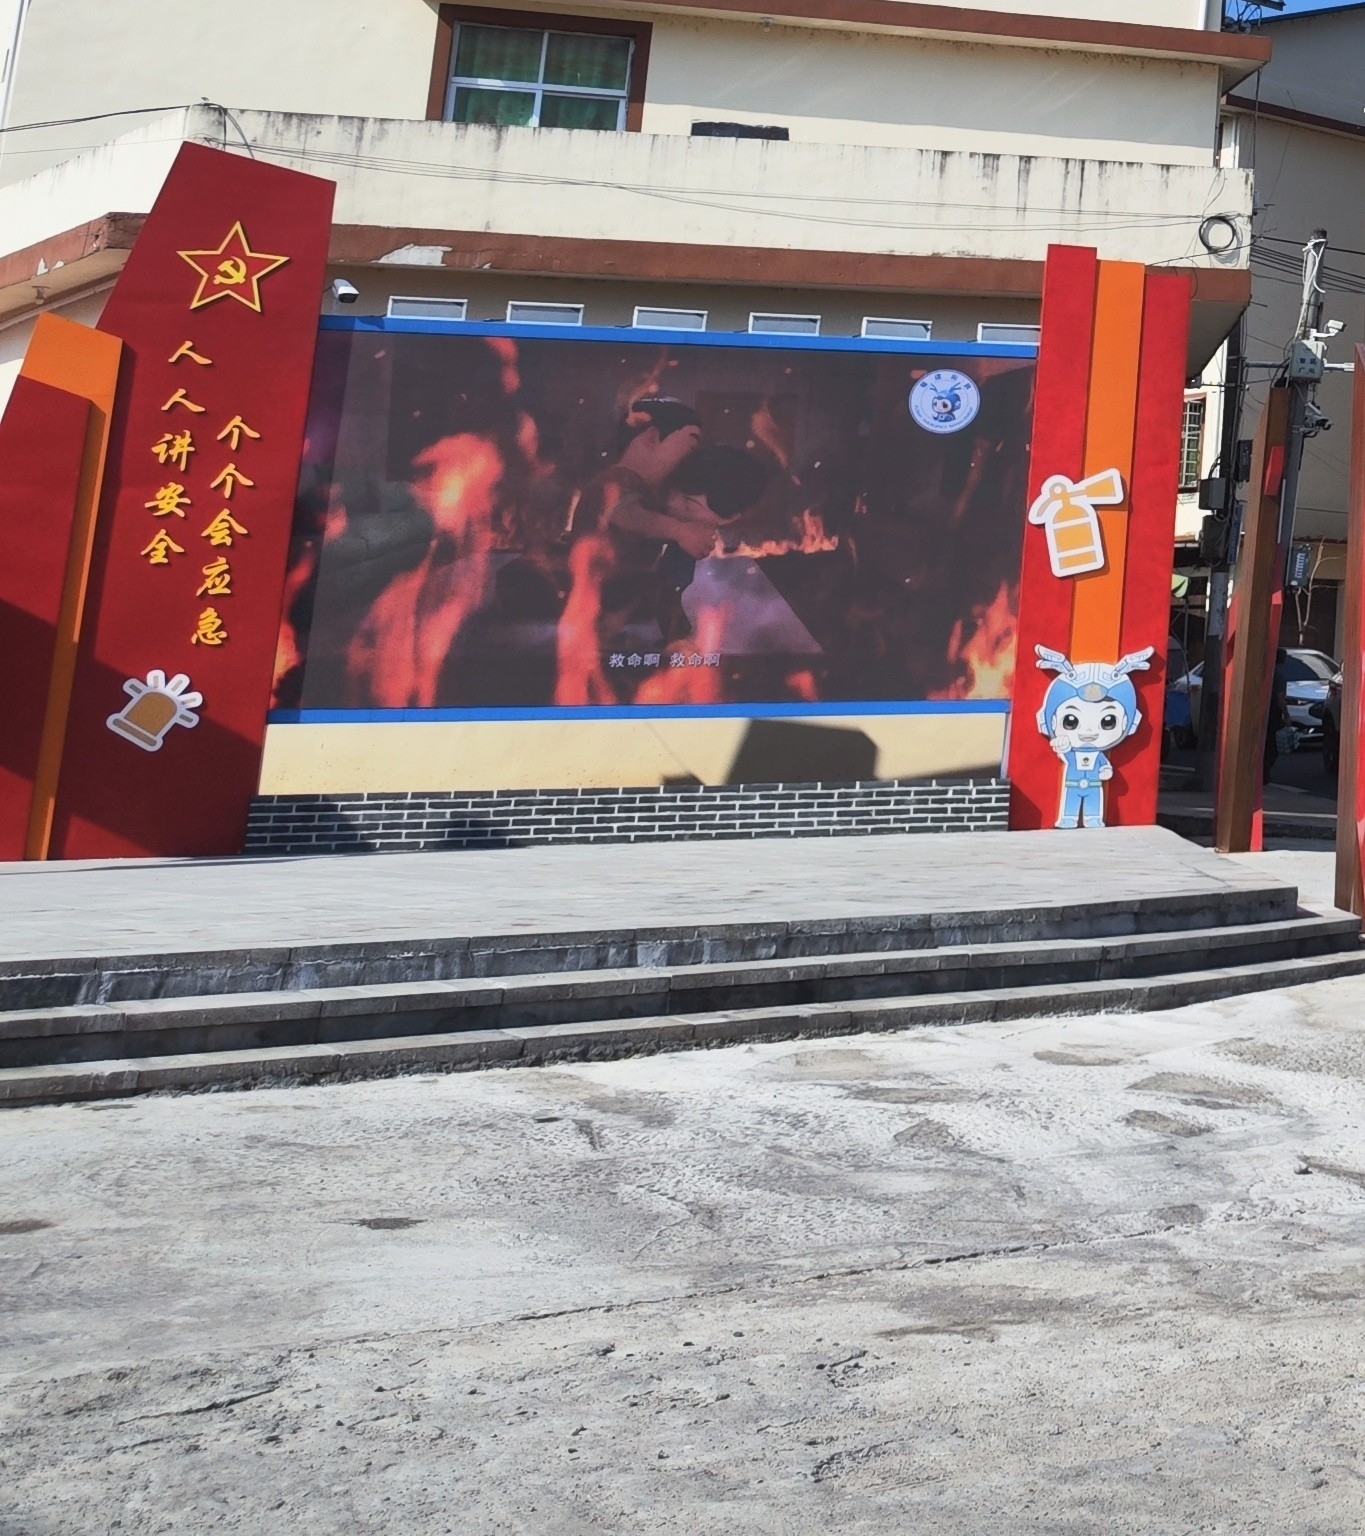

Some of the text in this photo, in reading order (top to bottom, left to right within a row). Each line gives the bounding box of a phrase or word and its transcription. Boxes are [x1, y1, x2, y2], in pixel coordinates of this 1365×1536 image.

[141, 340, 213, 565] 人人讲安全
[191, 415, 261, 646] 个个会应急
[608, 652, 721, 668] 救命啊 救命啊
